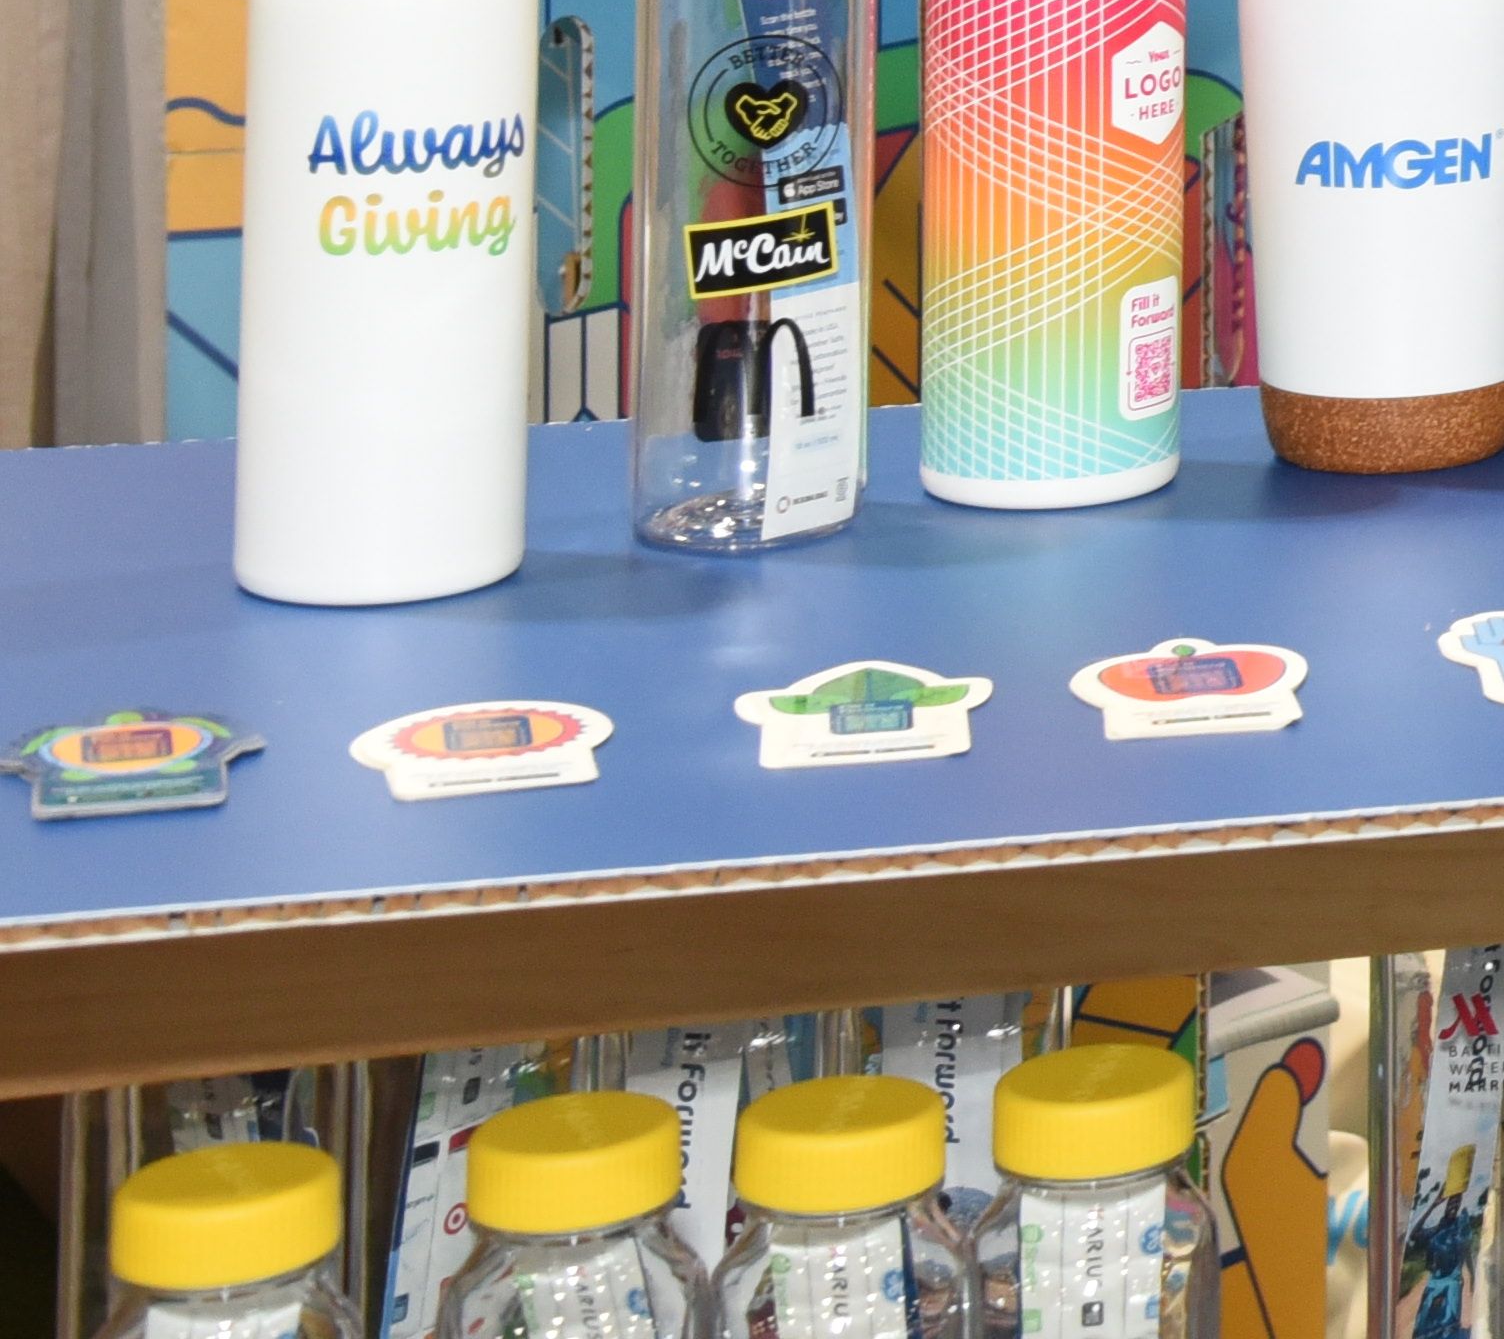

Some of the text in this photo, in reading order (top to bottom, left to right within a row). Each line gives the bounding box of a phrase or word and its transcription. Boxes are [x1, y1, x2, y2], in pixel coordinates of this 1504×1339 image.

[1124, 65, 1182, 100] LOGO
[1138, 98, 1175, 121] HERE
[308, 109, 525, 177] Always
[711, 139, 818, 176] TOGETHER
[1295, 132, 1492, 190] AMGEN
[797, 181, 820, 198] App
[319, 188, 516, 258] Giving
[694, 231, 830, 284] McCain
[1131, 293, 1160, 313] Fill it
[1131, 304, 1176, 330] Forward
